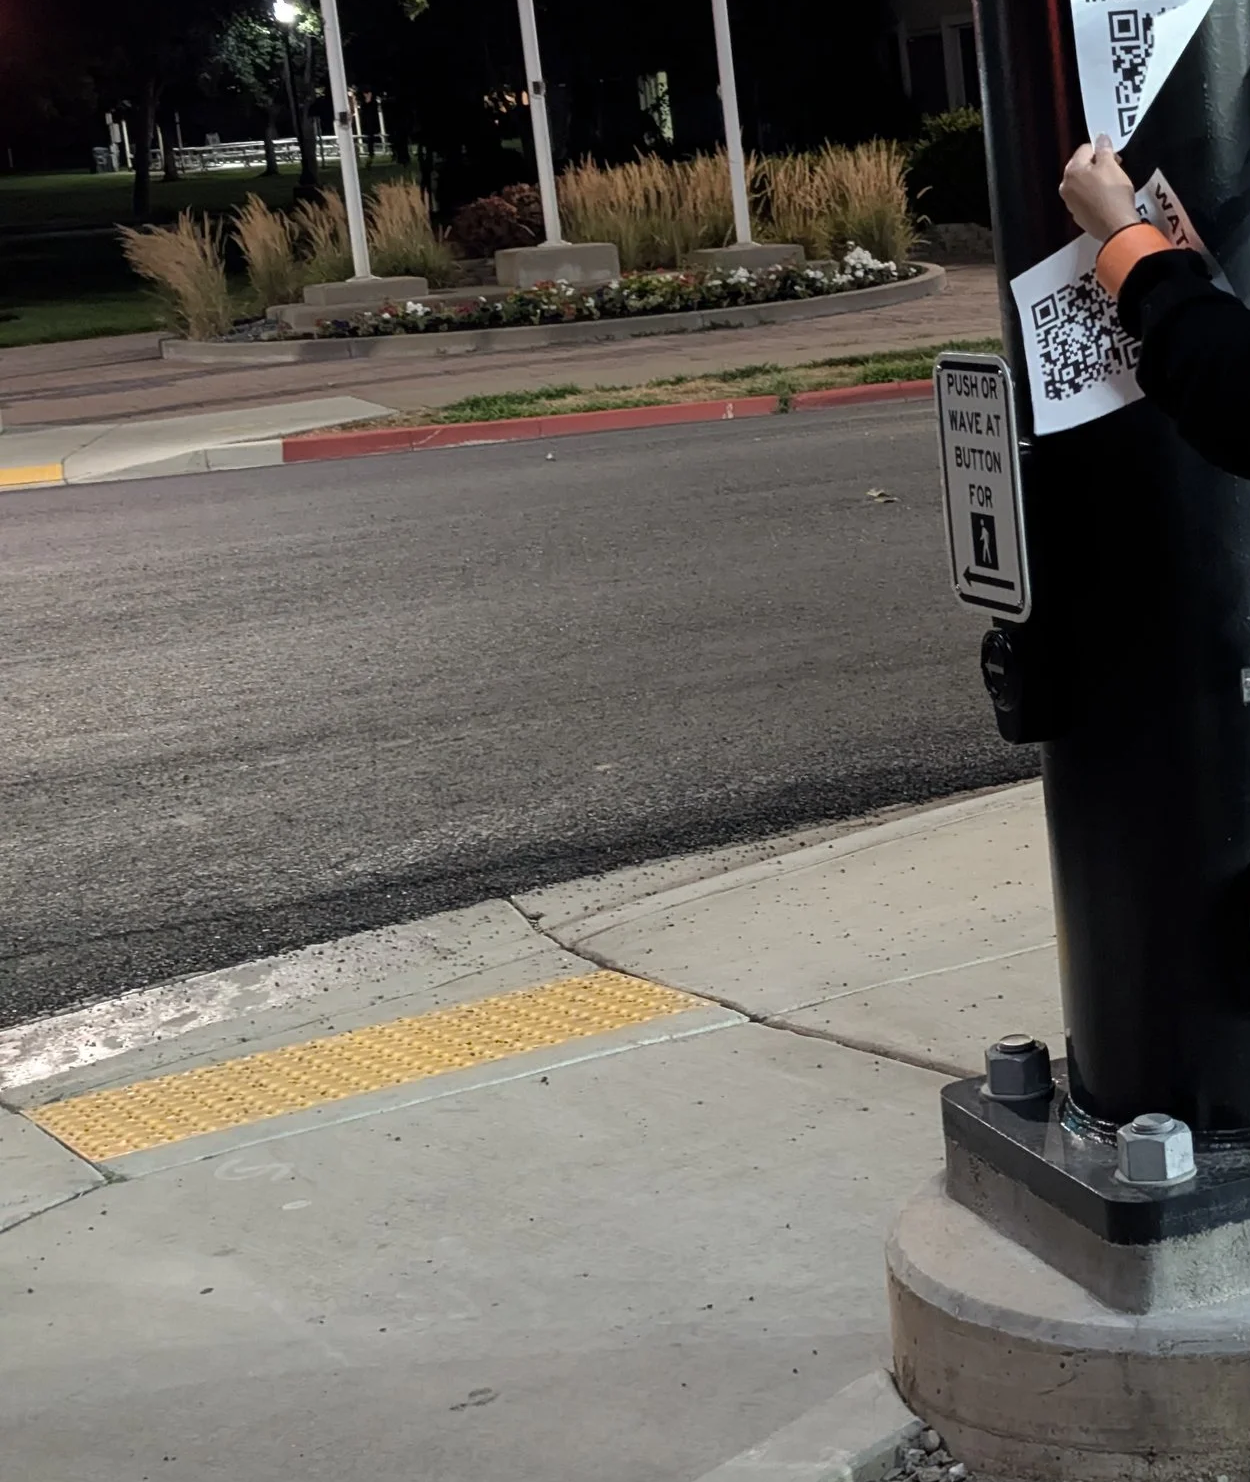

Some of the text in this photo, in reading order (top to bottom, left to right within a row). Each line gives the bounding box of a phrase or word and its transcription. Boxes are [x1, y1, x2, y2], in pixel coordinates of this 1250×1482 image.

[1155, 183, 1192, 250] WAT
[947, 373, 998, 400] PUSH OR
[948, 409, 1000, 438] WAVE AT
[954, 446, 1001, 473] BUTTON
[969, 483, 993, 508] FOR
